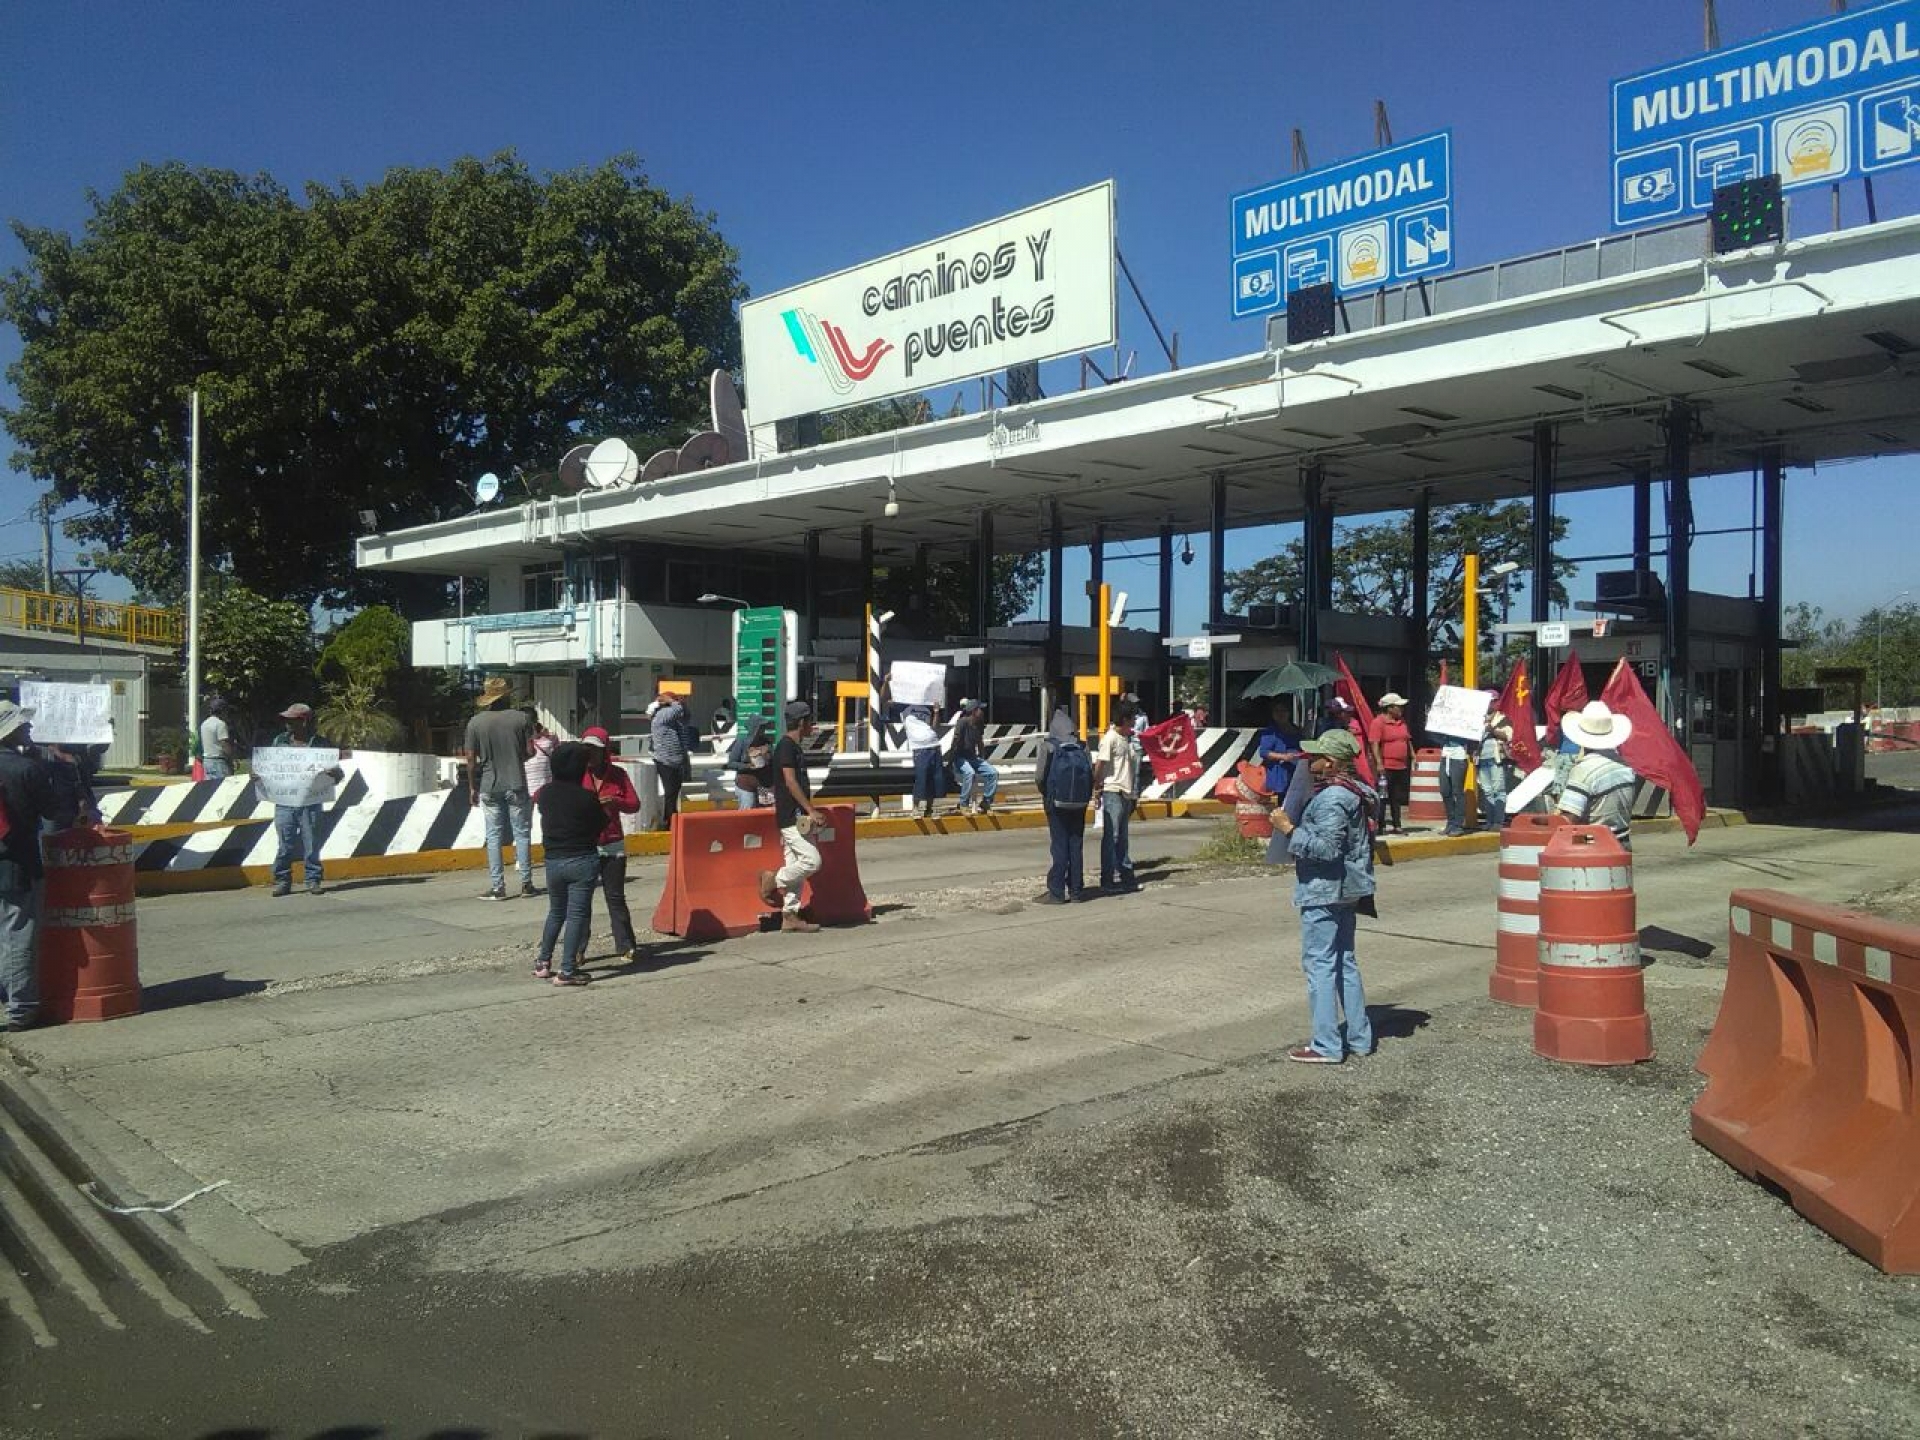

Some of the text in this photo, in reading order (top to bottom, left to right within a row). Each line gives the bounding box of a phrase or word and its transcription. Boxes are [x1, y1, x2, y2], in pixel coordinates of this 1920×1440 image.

[1633, 21, 1920, 131] MULTIMODAL
[1245, 158, 1434, 239] MULTIMODAL
[863, 228, 1052, 316] caminos Y
[904, 294, 1055, 378] puentes
[1638, 662, 1657, 676] 1B
